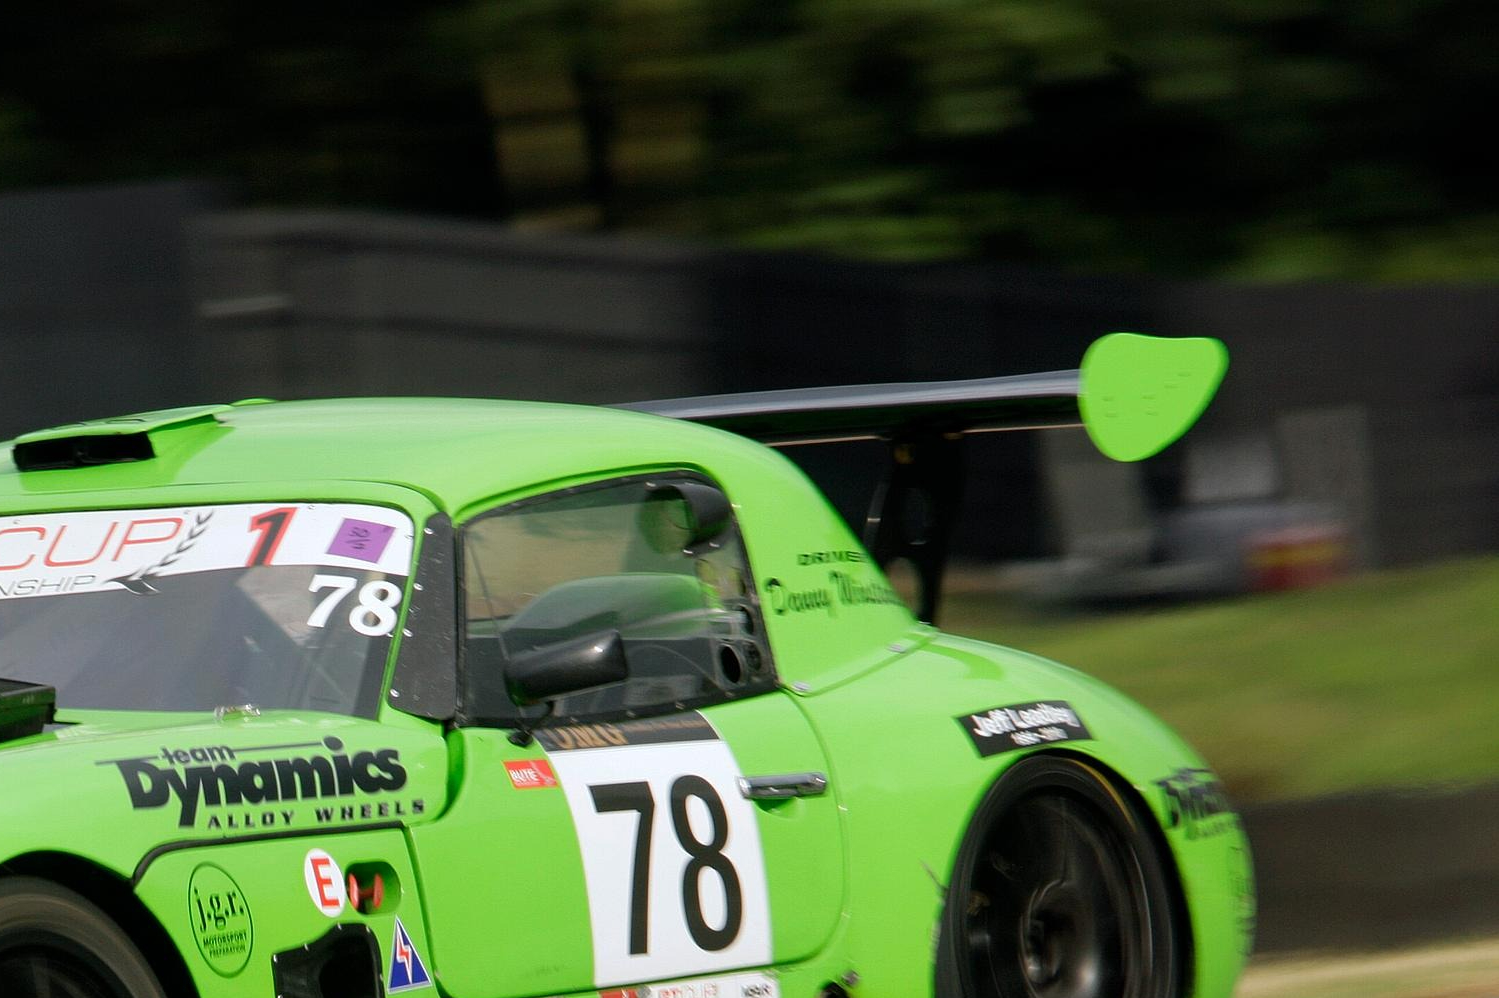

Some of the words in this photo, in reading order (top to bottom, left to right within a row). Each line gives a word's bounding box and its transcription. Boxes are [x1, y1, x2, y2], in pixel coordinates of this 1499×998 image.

[246, 506, 298, 567] 1
[307, 574, 402, 636] 78
[116, 736, 407, 828] Dynamics
[160, 744, 236, 766] team
[208, 808, 295, 830] ALLOY
[315, 799, 425, 823] WHEELS
[311, 858, 340, 908] E
[588, 774, 743, 955] 78
